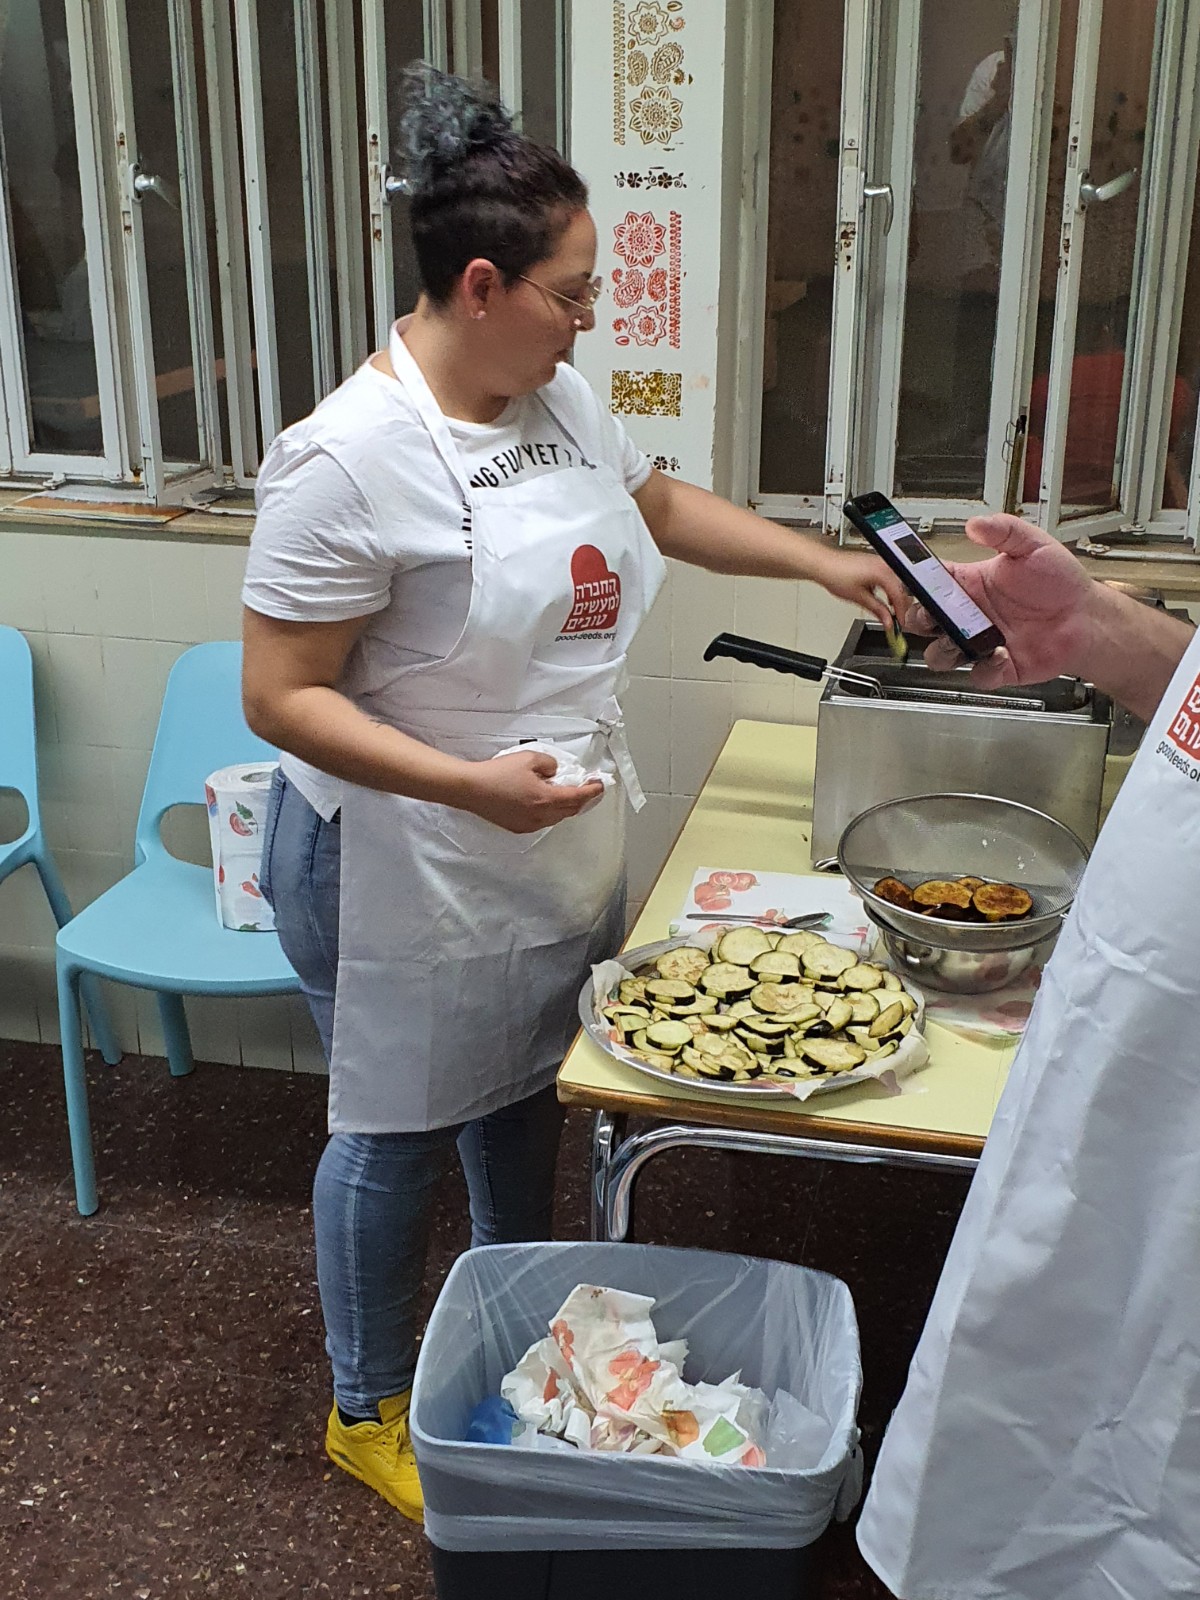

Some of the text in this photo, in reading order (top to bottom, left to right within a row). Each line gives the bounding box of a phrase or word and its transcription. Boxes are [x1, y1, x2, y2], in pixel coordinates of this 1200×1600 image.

[521, 443, 559, 466] YET
[573, 591, 620, 616] למעשים
[566, 613, 608, 630] טובים
